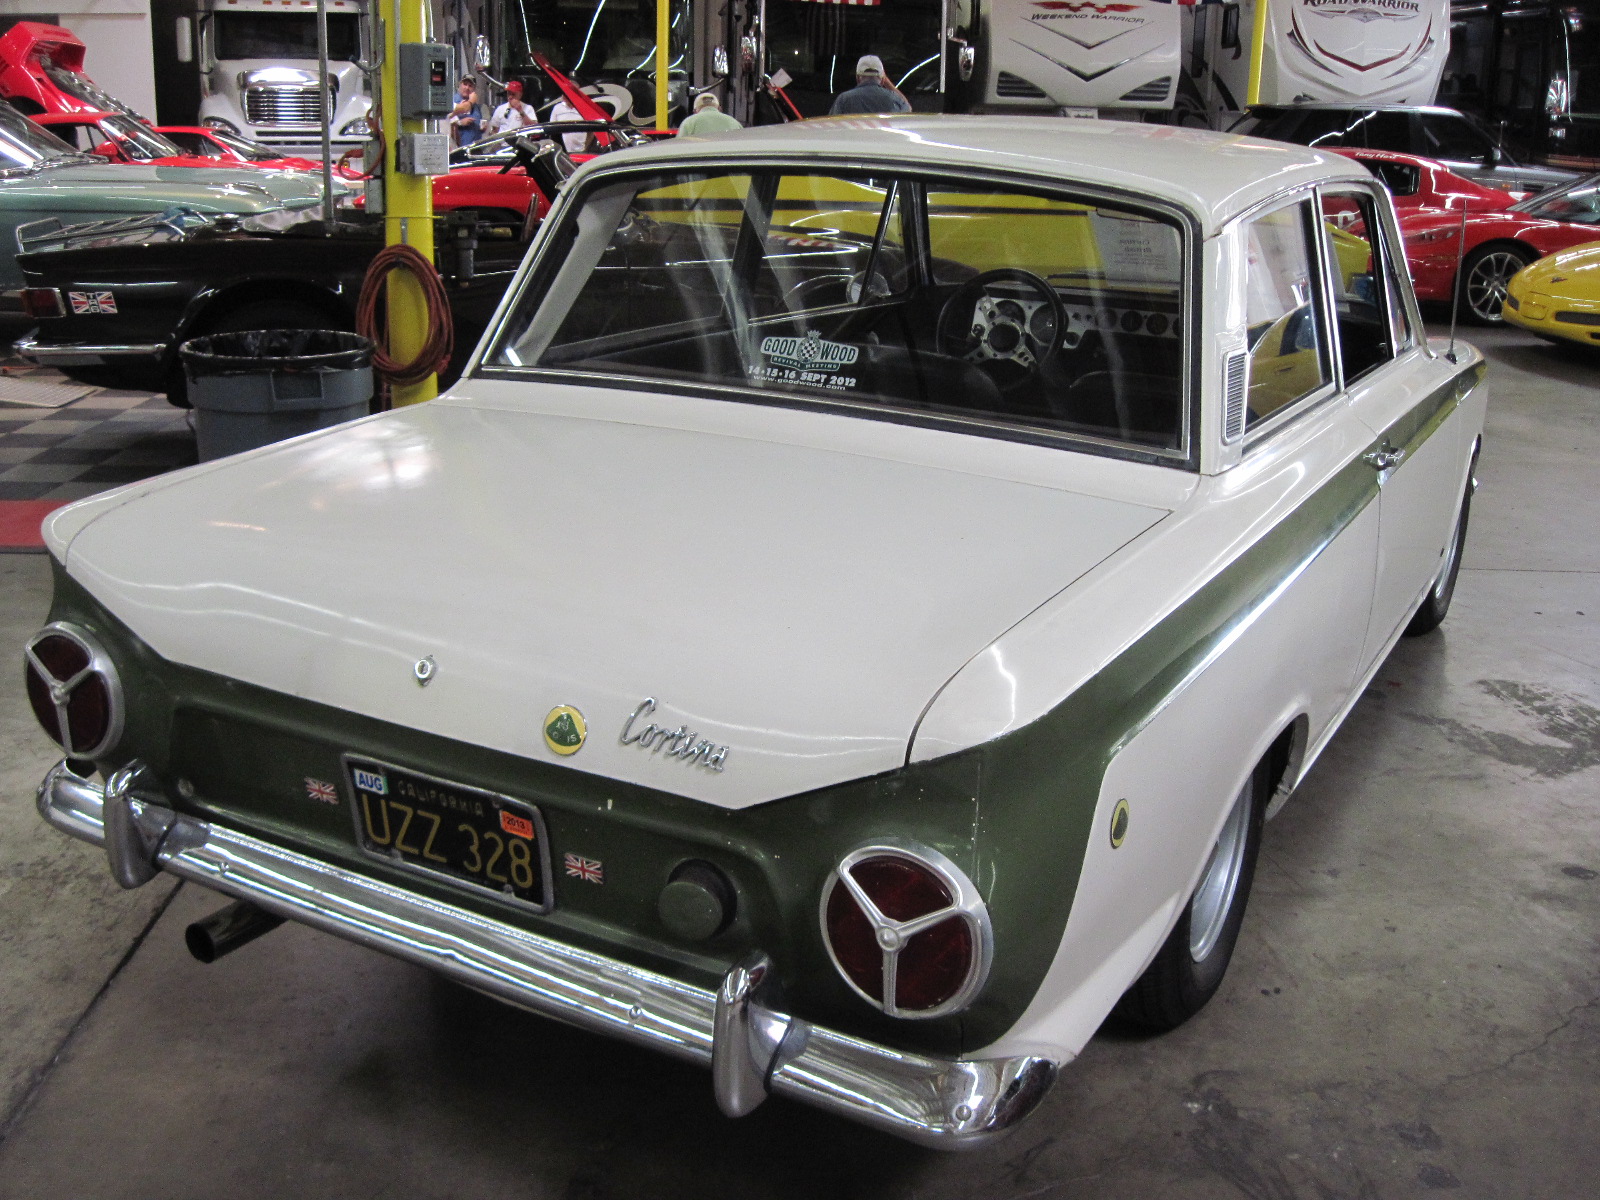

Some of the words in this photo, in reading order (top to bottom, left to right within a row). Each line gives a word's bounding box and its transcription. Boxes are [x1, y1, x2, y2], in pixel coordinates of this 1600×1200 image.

[1091, 14, 1145, 23] WARRIOR
[763, 338, 797, 356] GOOD
[820, 342, 856, 362] WOOD
[753, 375, 846, 391] www.goodwood.com
[800, 371, 828, 383] SEPT
[829, 375, 857, 387] 2012
[618, 697, 729, 773] Cortina
[359, 772, 383, 792] AUG
[398, 781, 483, 816] CALIFORNIA
[506, 817, 526, 830] 2013
[361, 793, 448, 864] UZZ
[458, 824, 534, 889] 328
